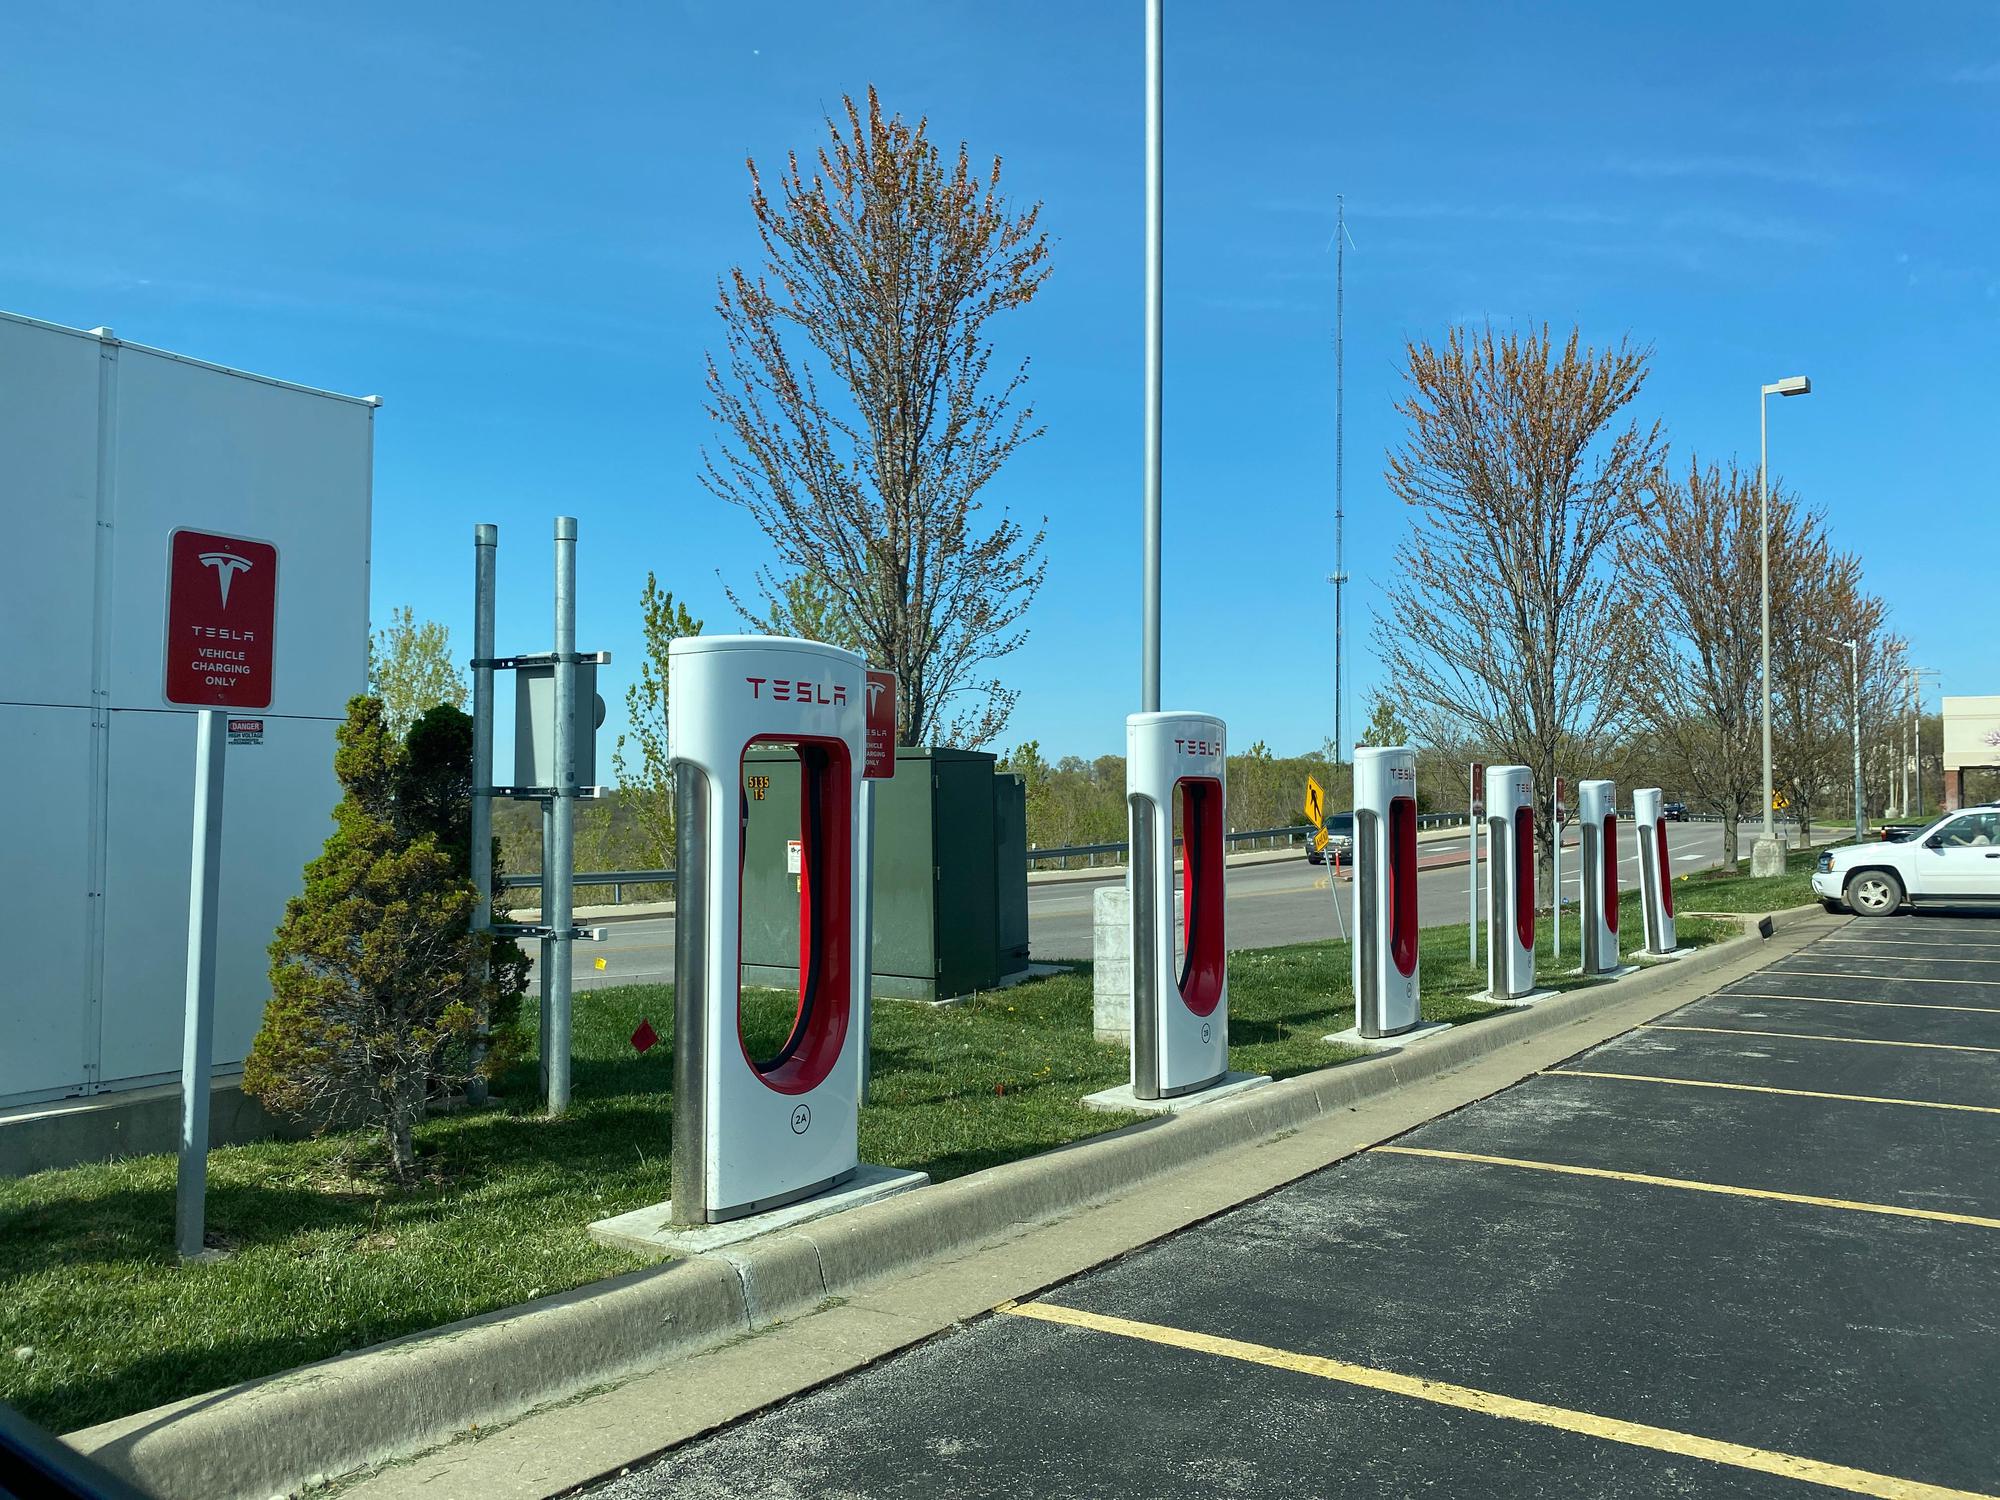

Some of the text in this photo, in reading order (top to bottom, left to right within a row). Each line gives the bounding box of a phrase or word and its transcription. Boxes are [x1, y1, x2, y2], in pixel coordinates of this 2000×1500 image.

[191, 625, 254, 642] TESLA
[198, 647, 246, 661] VEHICLE
[191, 661, 251, 674] CHARGING
[205, 676, 236, 687] ONLY
[745, 677, 847, 706] TESLA
[232, 722, 260, 731] DANGER
[865, 728, 887, 737] ESLA
[1174, 739, 1221, 756] TESLA
[748, 776, 769, 788] 5135
[795, 1113, 807, 1125] 2A
